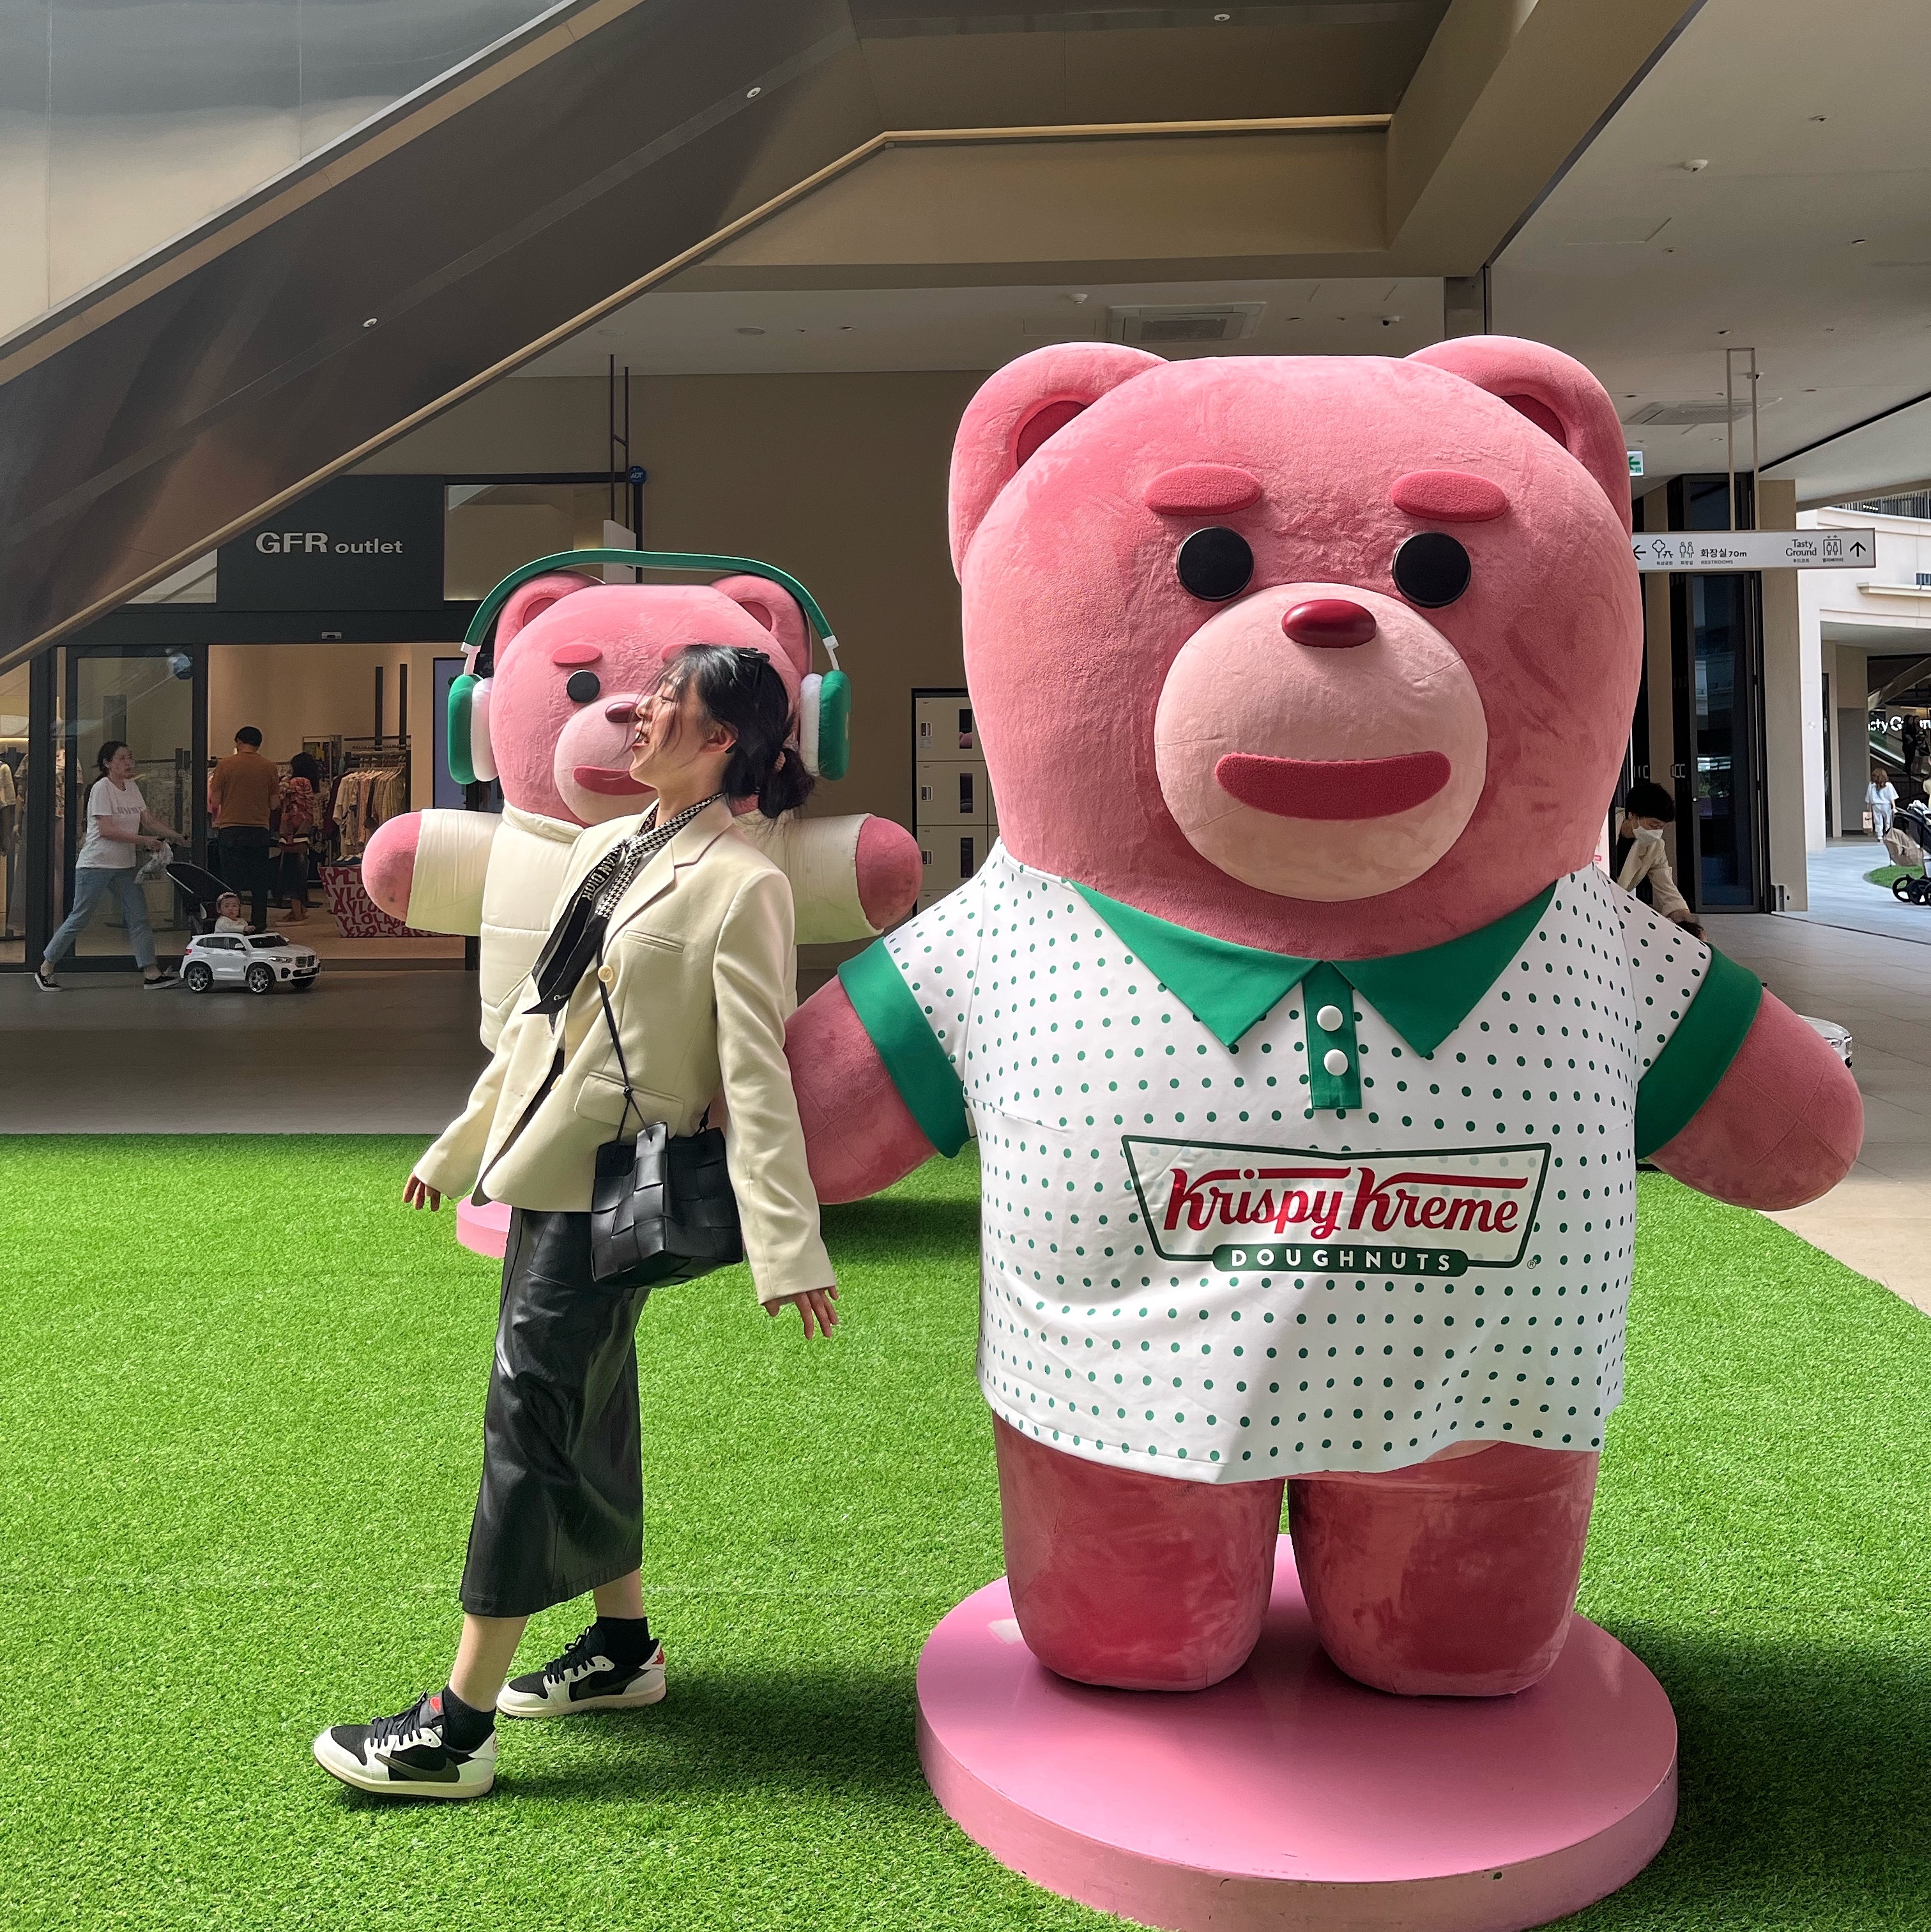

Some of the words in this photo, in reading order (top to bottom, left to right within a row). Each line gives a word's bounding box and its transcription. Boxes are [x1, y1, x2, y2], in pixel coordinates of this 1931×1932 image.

[256, 532, 328, 554] GFR
[335, 538, 403, 554] outlet
[1700, 548, 1727, 558] 화장실
[1785, 547, 1817, 556] Ground
[1792, 539, 1813, 549] Tasty
[582, 872, 606, 901] DIOR
[1164, 1168, 1351, 1239] Krispy
[1348, 1168, 1529, 1233] Kreme
[1231, 1249, 1451, 1271] DOUGHNUTS
